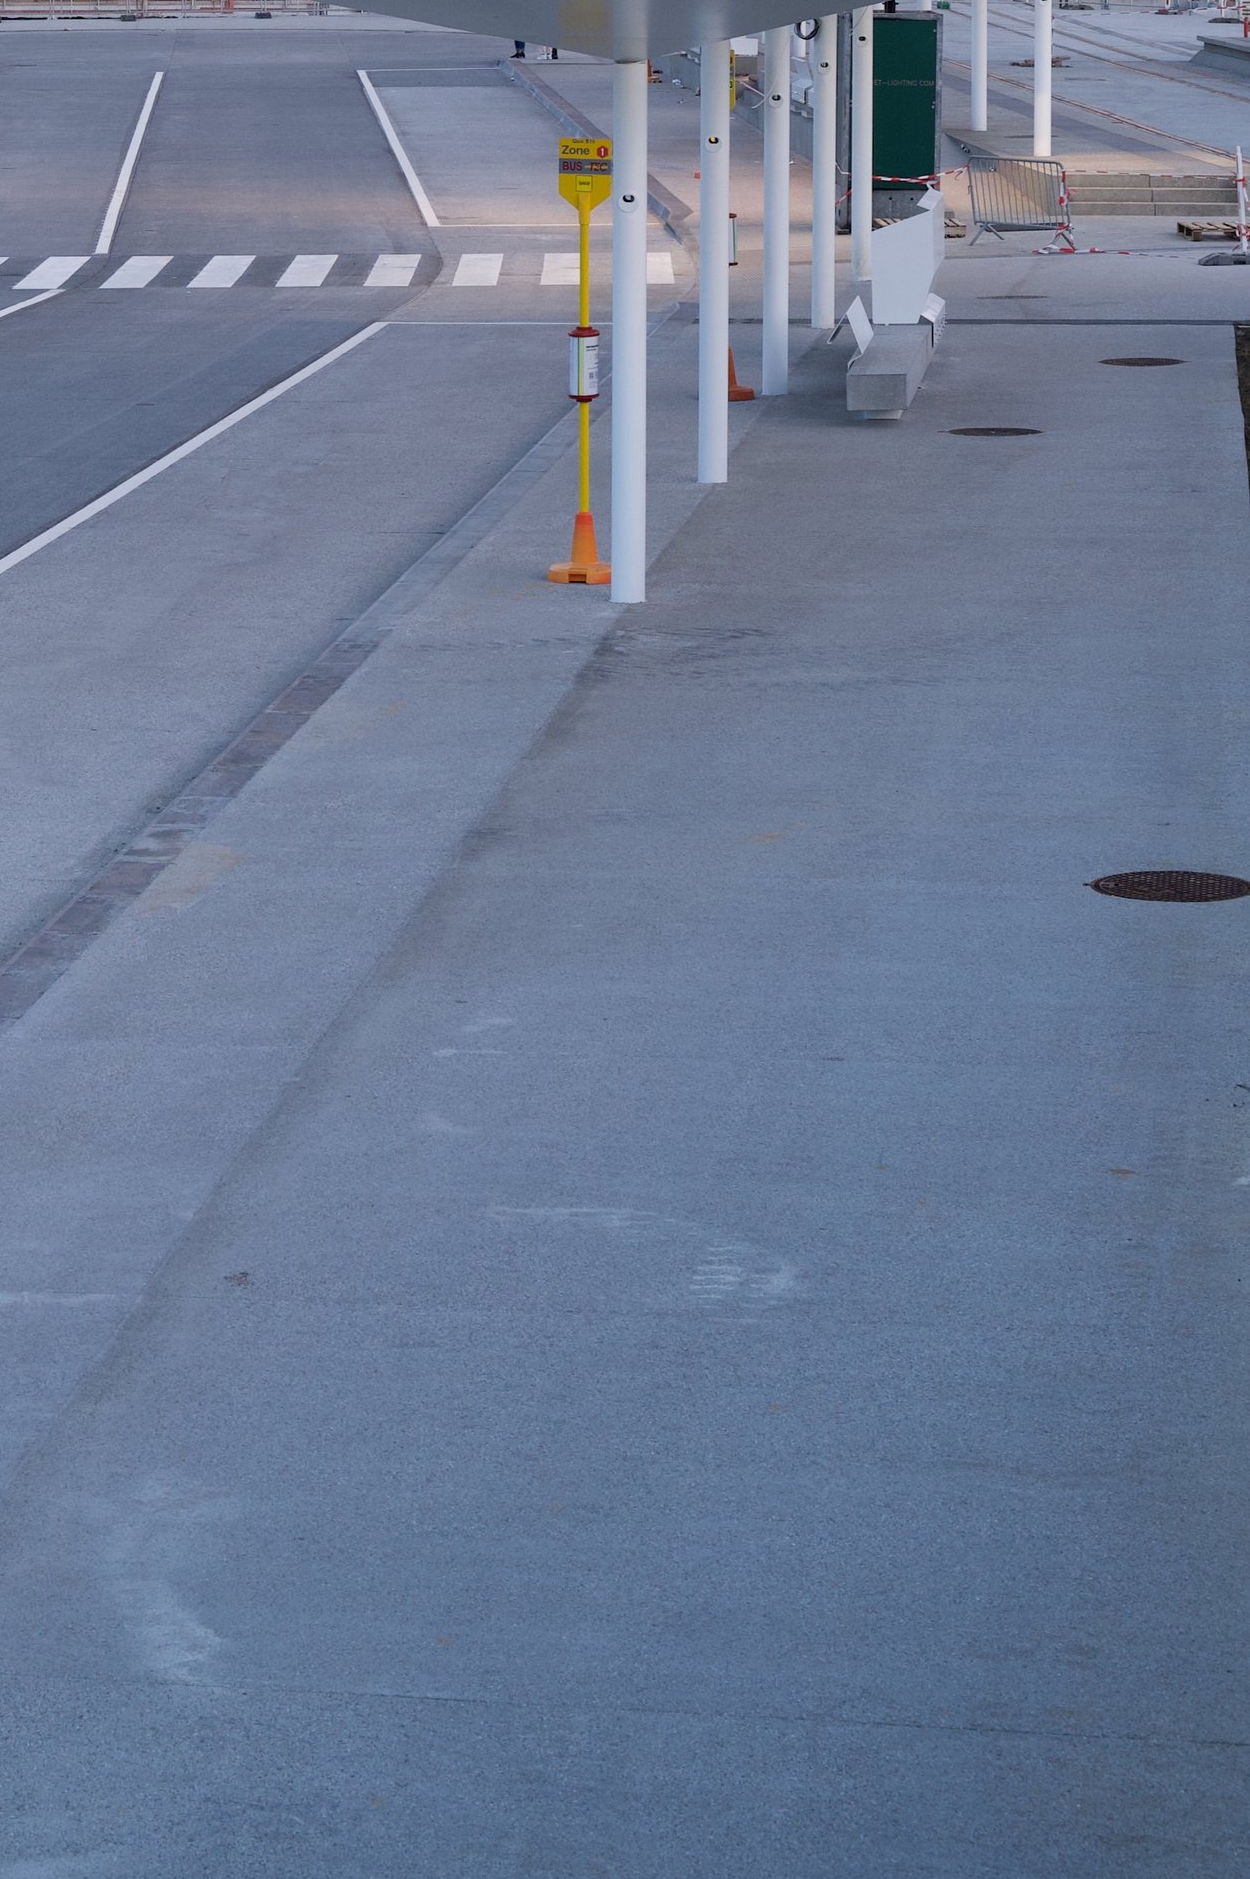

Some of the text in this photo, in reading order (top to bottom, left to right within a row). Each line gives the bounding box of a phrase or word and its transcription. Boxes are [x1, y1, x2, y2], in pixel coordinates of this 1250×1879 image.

[561, 145, 590, 155] Zone
[562, 161, 609, 172] BUS TEC
